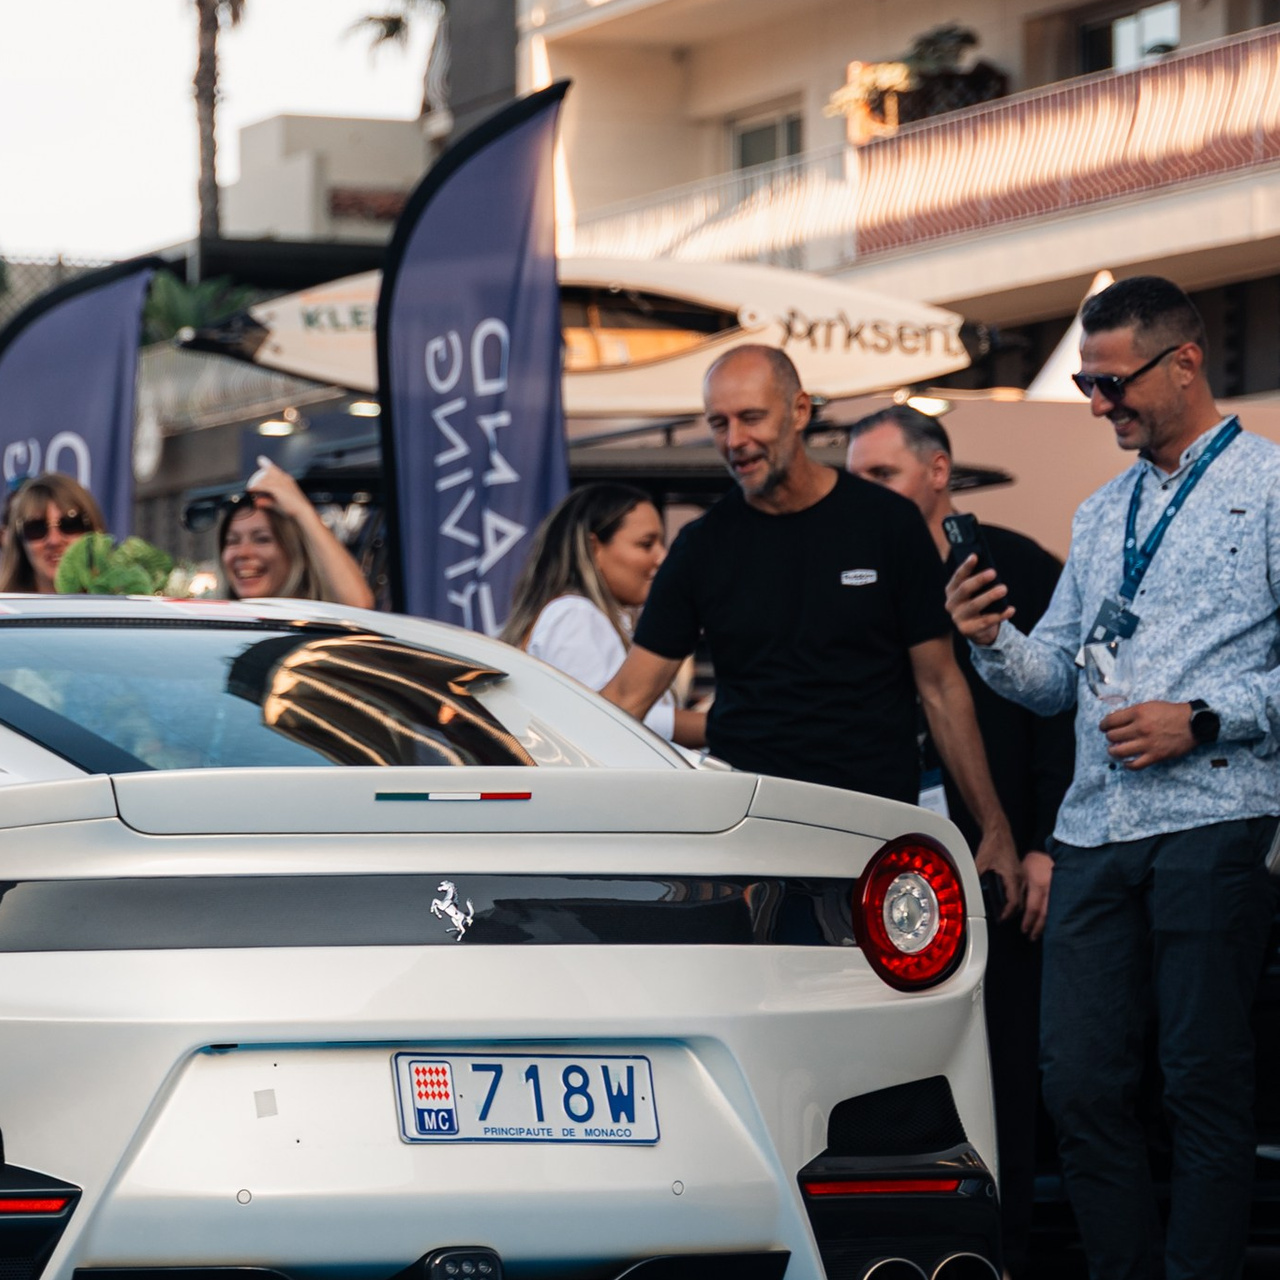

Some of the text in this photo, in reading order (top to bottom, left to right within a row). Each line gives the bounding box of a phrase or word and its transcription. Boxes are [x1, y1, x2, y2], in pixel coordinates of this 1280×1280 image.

[471, 1064, 636, 1123] 718W
[424, 1111, 450, 1130] MC
[484, 1127, 632, 1138] PRINCIPAUTE DE MONACO
